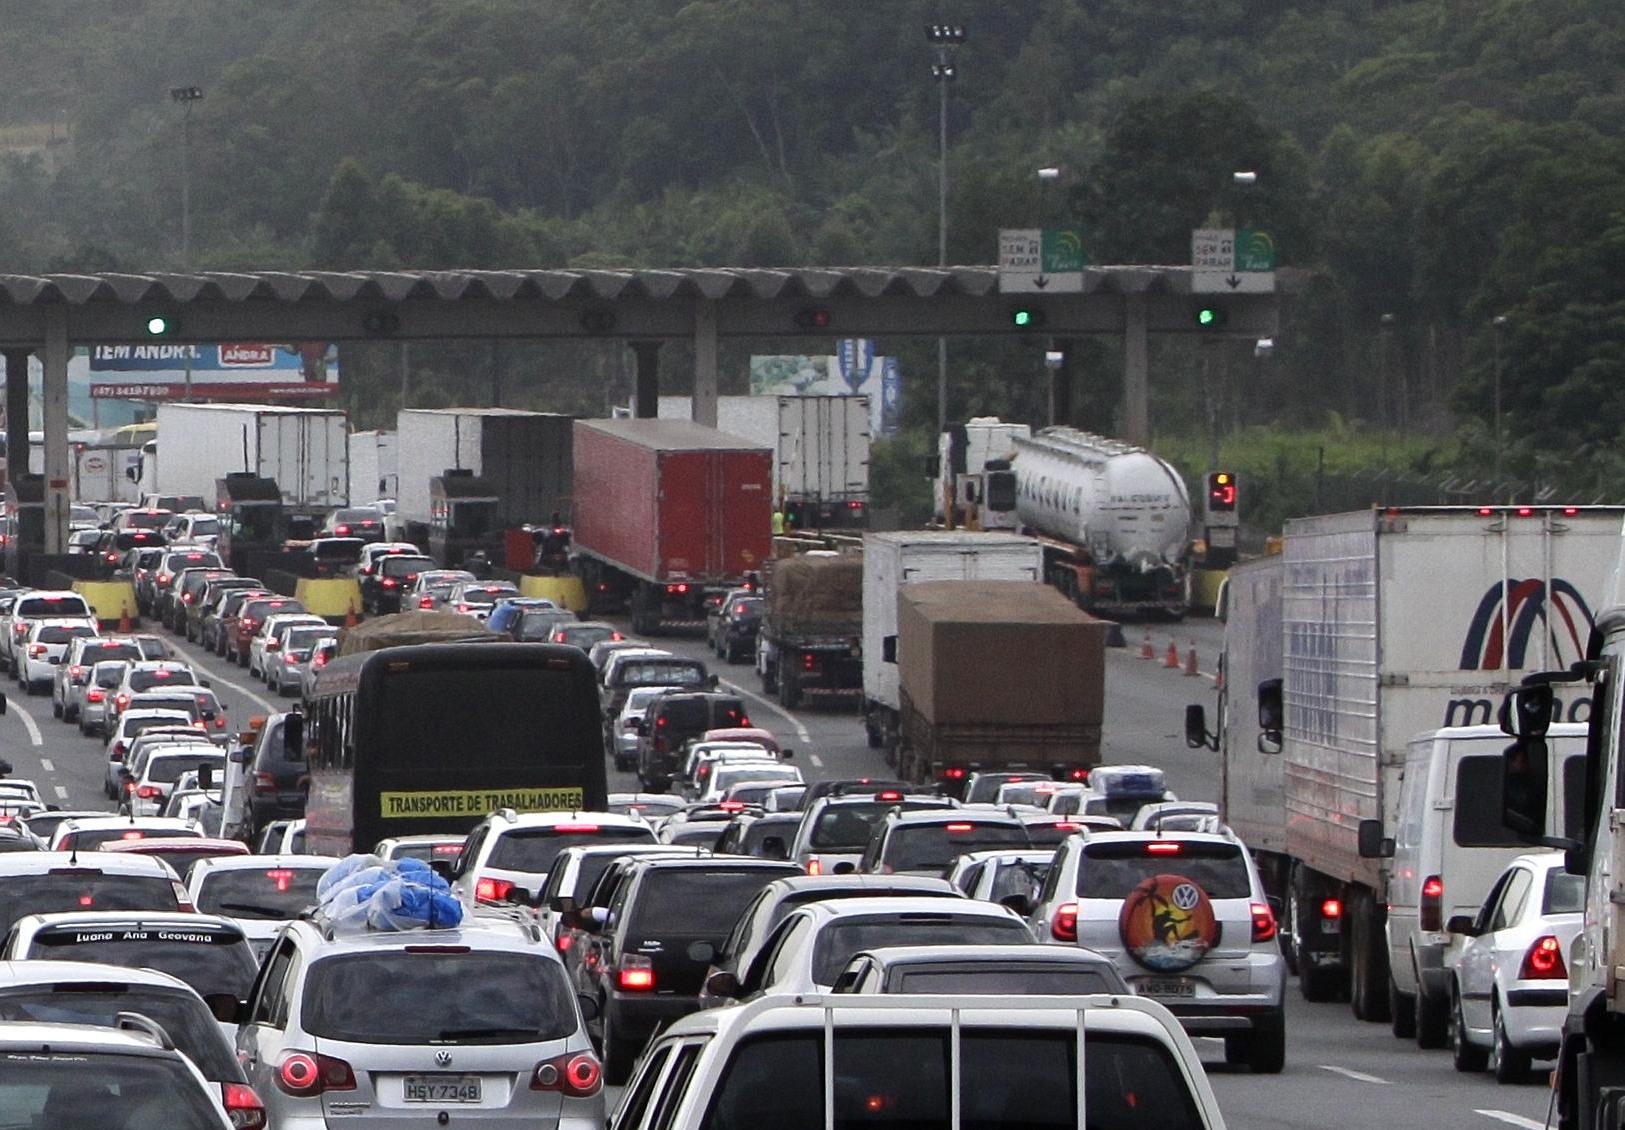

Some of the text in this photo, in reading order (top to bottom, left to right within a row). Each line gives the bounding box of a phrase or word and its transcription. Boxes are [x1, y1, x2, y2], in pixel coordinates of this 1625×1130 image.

[389, 792, 582, 812] TRANSPORTE DE TRABALHADORES
[77, 931, 212, 943] Luana Ana Geovana
